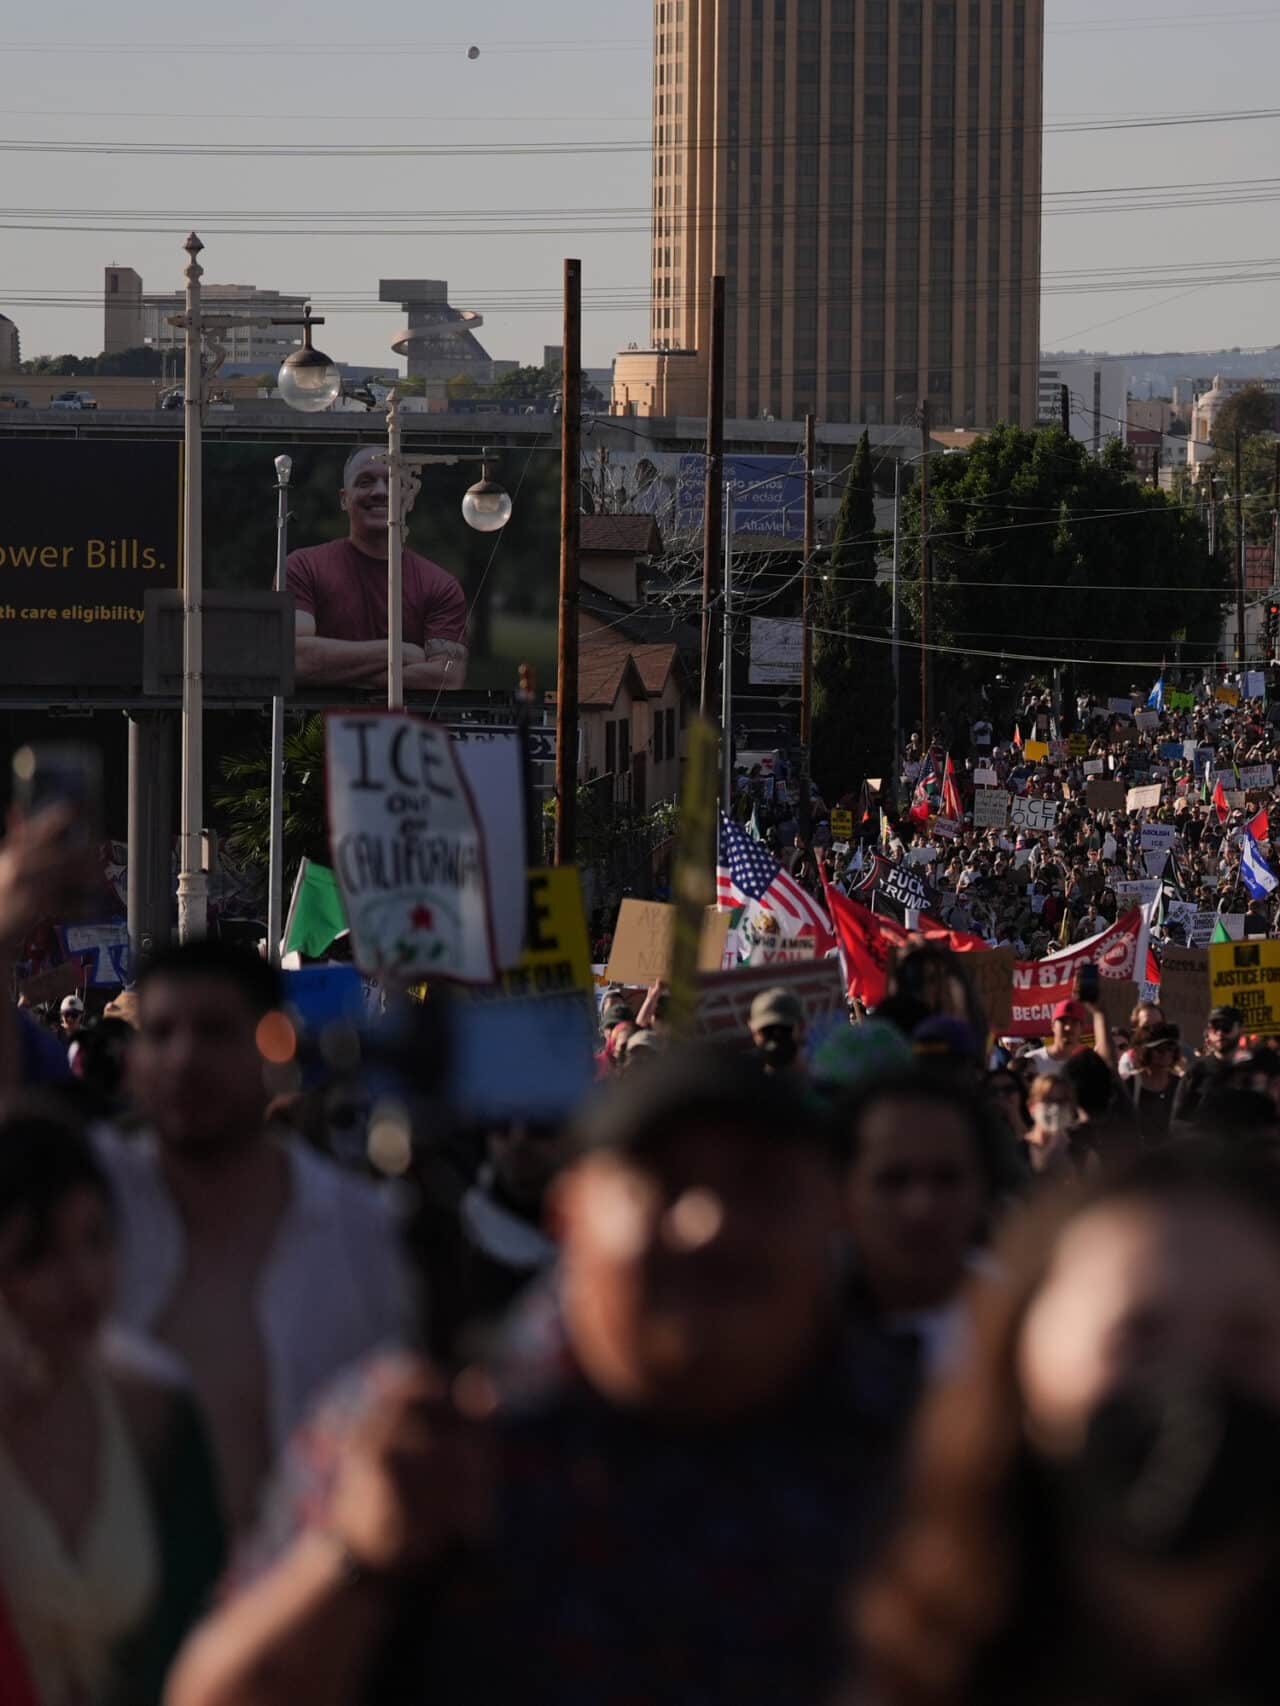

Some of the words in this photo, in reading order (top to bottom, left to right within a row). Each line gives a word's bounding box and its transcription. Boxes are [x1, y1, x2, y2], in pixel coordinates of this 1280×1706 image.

[87, 539, 166, 569] Bills.
[21, 607, 57, 620] care
[61, 603, 145, 624] eligibility
[341, 720, 455, 799] ICE
[1014, 798, 1054, 816] ICE
[1012, 811, 1054, 828] OUT
[888, 867, 926, 898] FUCK
[879, 877, 932, 910] TRUMP
[1214, 968, 1259, 987] JUSTICE
[1232, 990, 1265, 1009] KEITH
